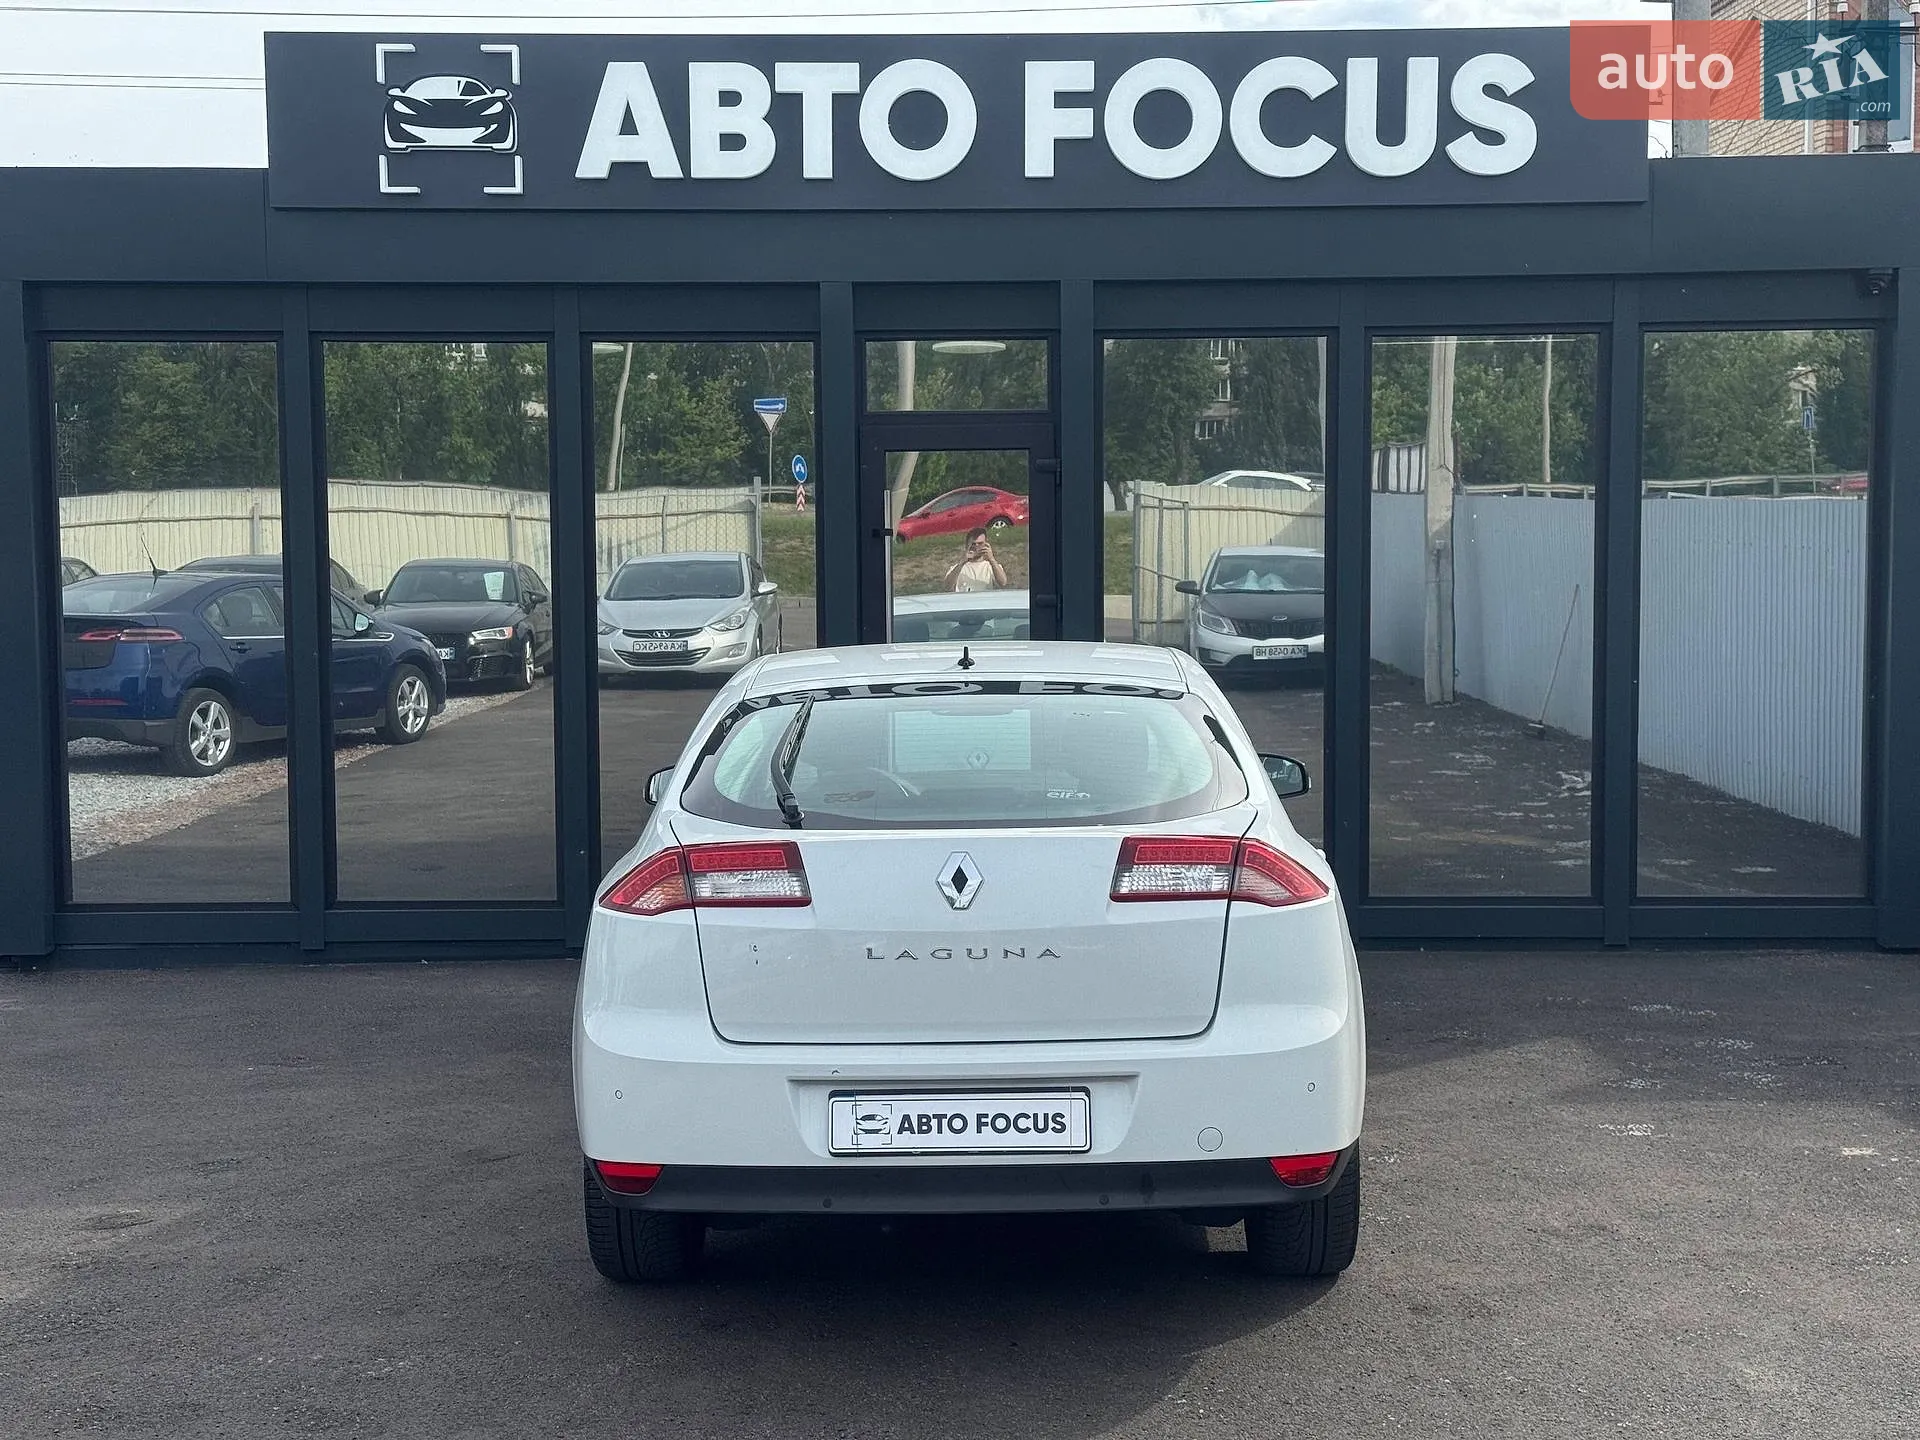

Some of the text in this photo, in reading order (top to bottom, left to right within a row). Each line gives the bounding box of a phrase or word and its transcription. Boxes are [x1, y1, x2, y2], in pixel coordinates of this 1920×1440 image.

[575, 53, 1539, 181] АВТО FOCUS
[866, 947, 1061, 960] LAGUNA
[897, 1112, 1067, 1135] АВТО FOCUS
